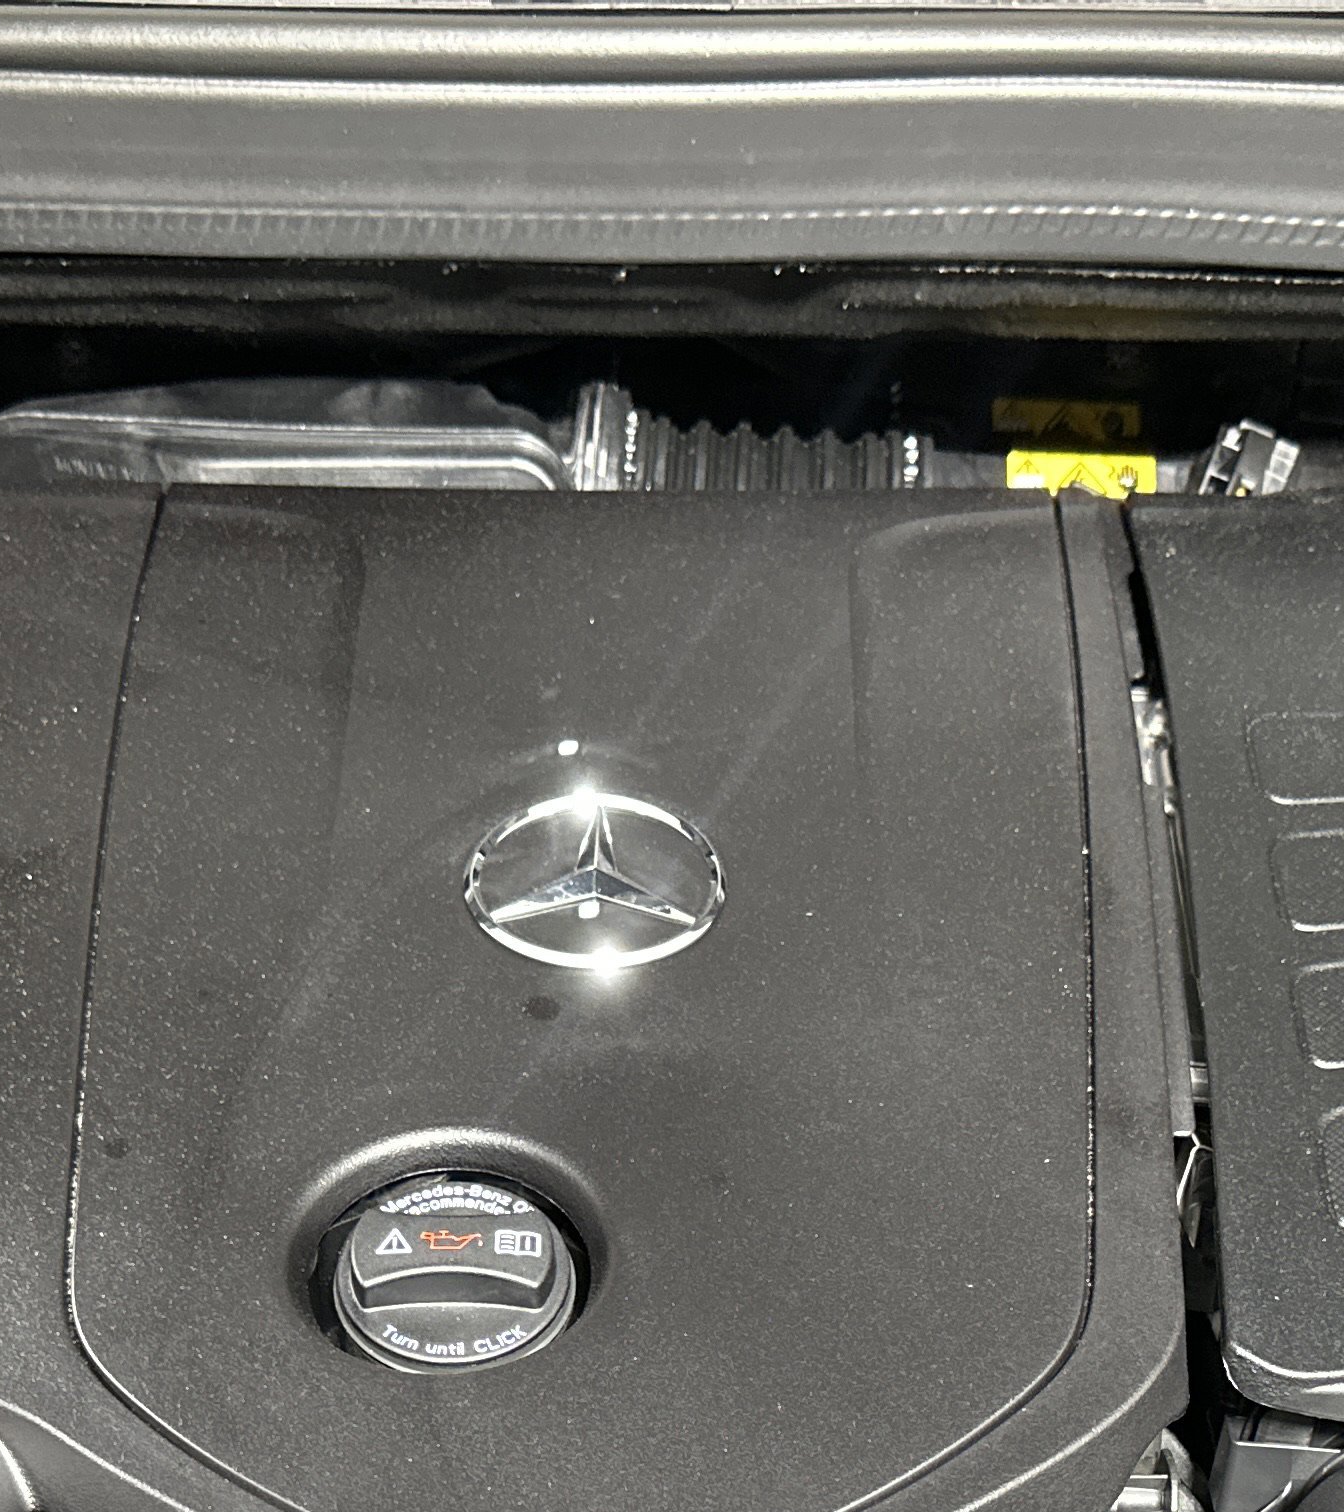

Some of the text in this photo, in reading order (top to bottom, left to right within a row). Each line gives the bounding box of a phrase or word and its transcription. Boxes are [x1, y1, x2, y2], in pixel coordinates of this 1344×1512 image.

[379, 1184, 512, 1213] Mercedes-Benz
[382, 1324, 527, 1355] Turn until CLICK
